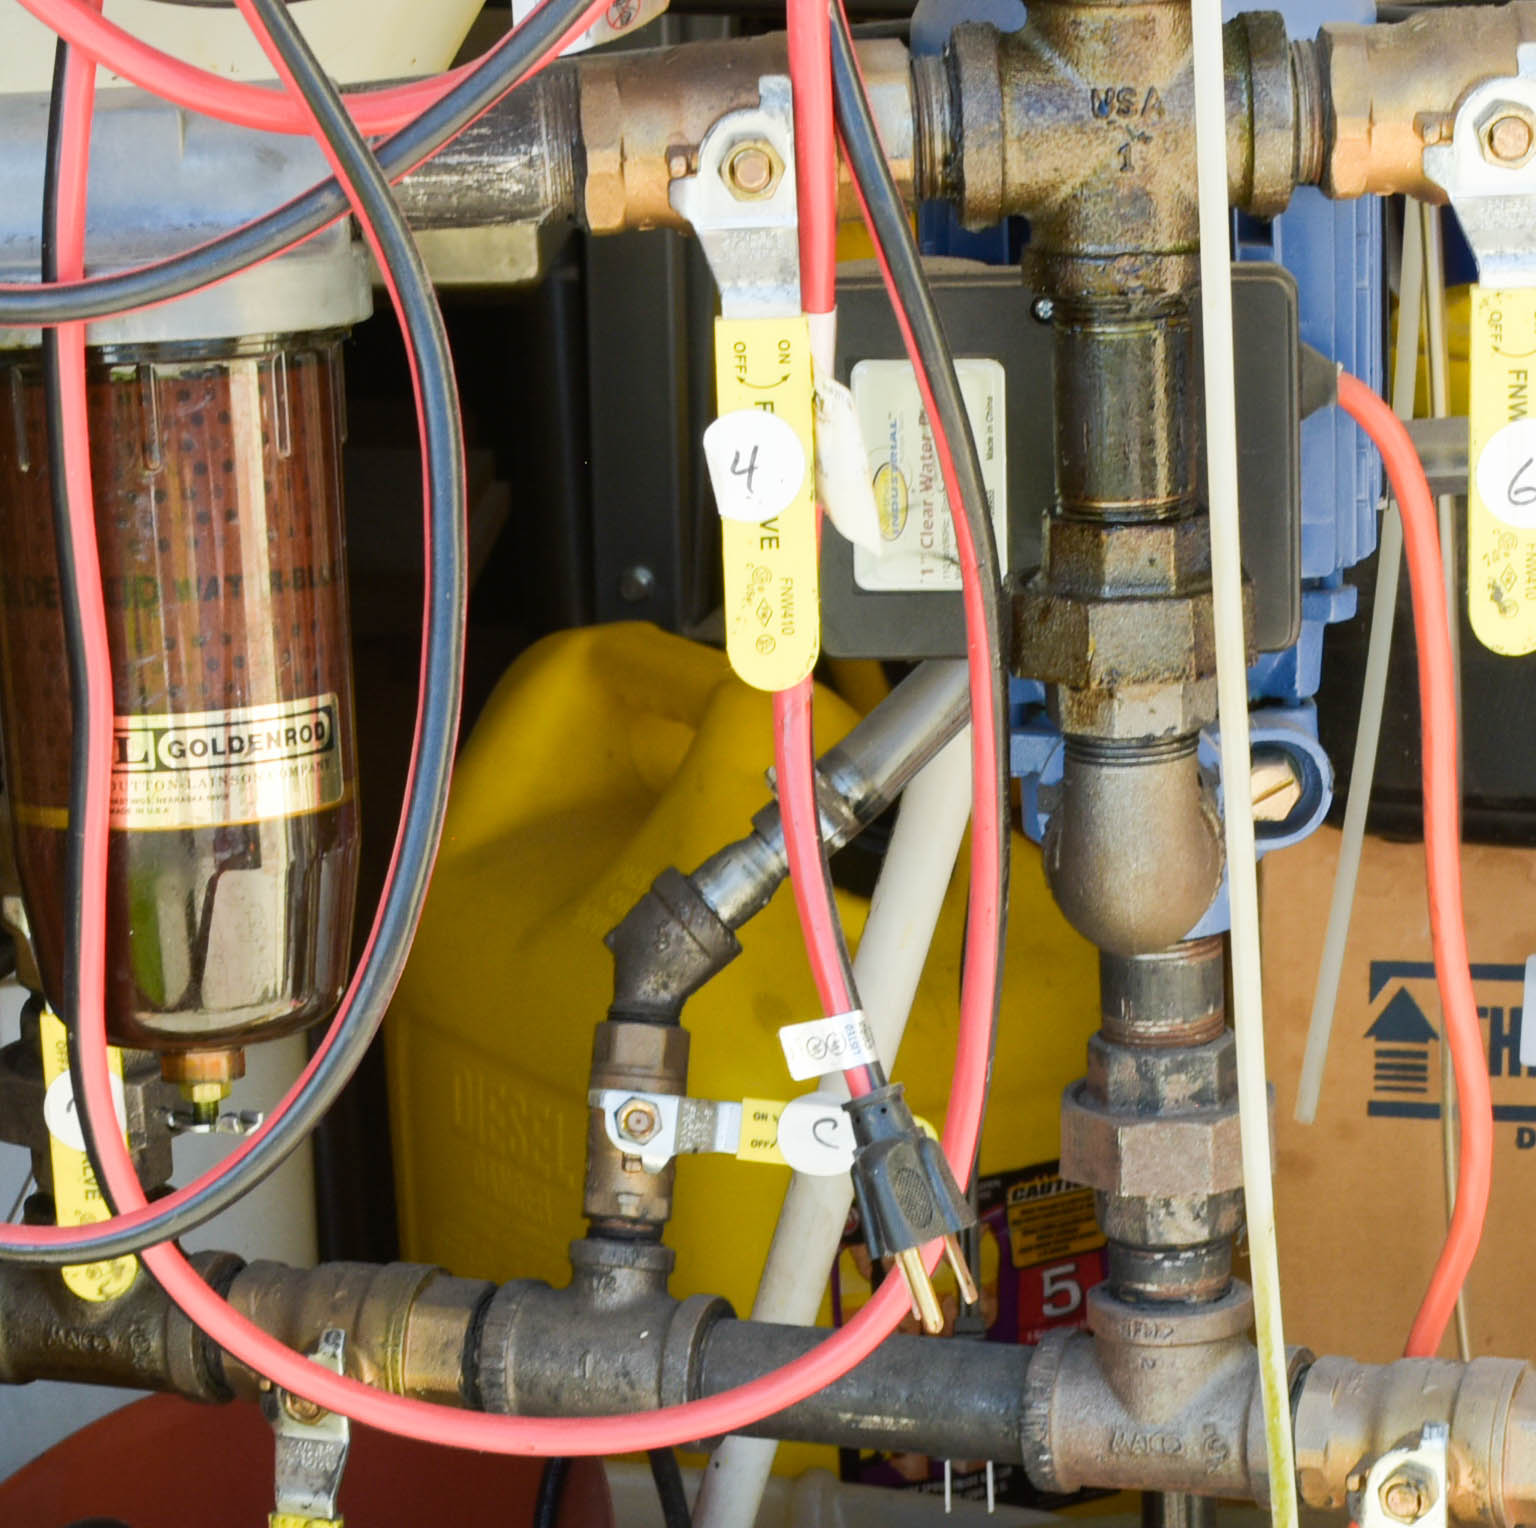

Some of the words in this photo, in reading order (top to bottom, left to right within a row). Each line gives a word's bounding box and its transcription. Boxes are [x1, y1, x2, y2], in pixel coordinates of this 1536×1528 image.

[1090, 86, 1166, 118] USA
[1489, 310, 1503, 343] OFF
[733, 341, 747, 374] OFF
[777, 339, 791, 365] ON
[729, 444, 760, 494] 4
[918, 434, 935, 494] Water
[918, 500, 935, 549] Clear
[779, 576, 795, 636] FNW410
[167, 720, 327, 761] GOLDENROD
[752, 1111, 770, 1122] ON
[812, 1116, 840, 1149] C
[1041, 1263, 1083, 1317] 5
